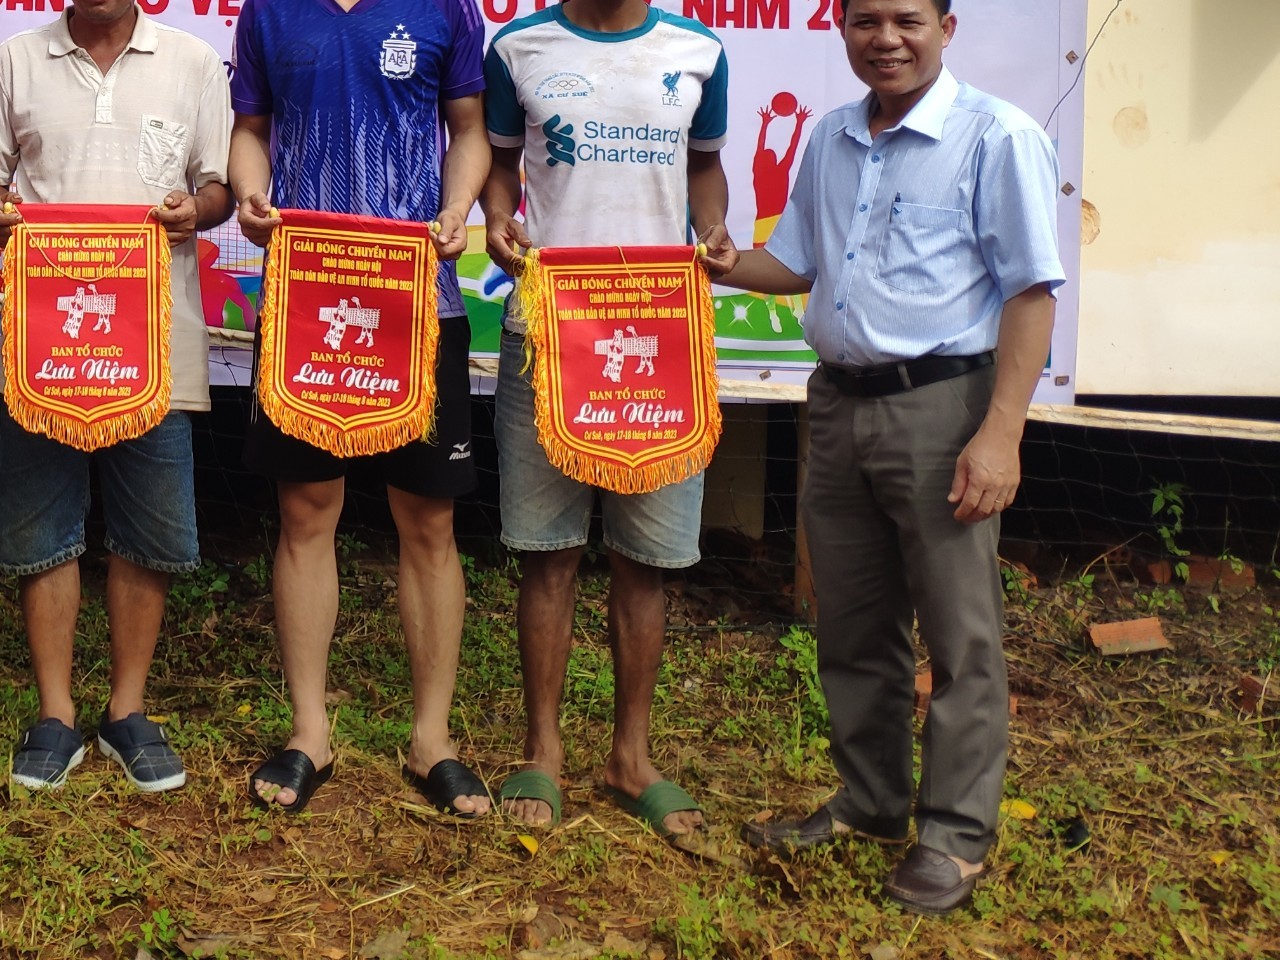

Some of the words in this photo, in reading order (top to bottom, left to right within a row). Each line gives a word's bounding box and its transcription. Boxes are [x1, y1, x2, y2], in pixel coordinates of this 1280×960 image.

[583, 120, 680, 144] Standard
[577, 143, 676, 166] Chartered
[52, 235, 79, 248] BÓNG
[82, 235, 119, 248] CHUYỀN
[122, 238, 143, 248] NAM
[293, 239, 314, 252] GIẢI
[316, 241, 345, 255] BÓNG
[348, 245, 386, 258] CHUYỀN
[389, 249, 412, 261] NAM
[558, 276, 579, 290] GIẢI
[582, 277, 612, 290] BÓNG
[658, 277, 682, 288] NAM
[52, 347, 73, 356] BAN
[76, 343, 90, 356] TỔ
[93, 345, 123, 357] CHỨC
[311, 352, 333, 362] BAN
[336, 351, 350, 364] TỔ
[354, 355, 384, 367] CHỨC
[35, 359, 76, 379] Lưu
[81, 359, 140, 385] Niệm
[293, 363, 335, 385] Lưu
[340, 367, 400, 395] Niệm
[589, 391, 612, 400] BAN
[615, 387, 630, 400] TỔ
[634, 388, 665, 400] CHỨC
[573, 403, 617, 423] Lưu
[622, 402, 685, 428] Niệm
